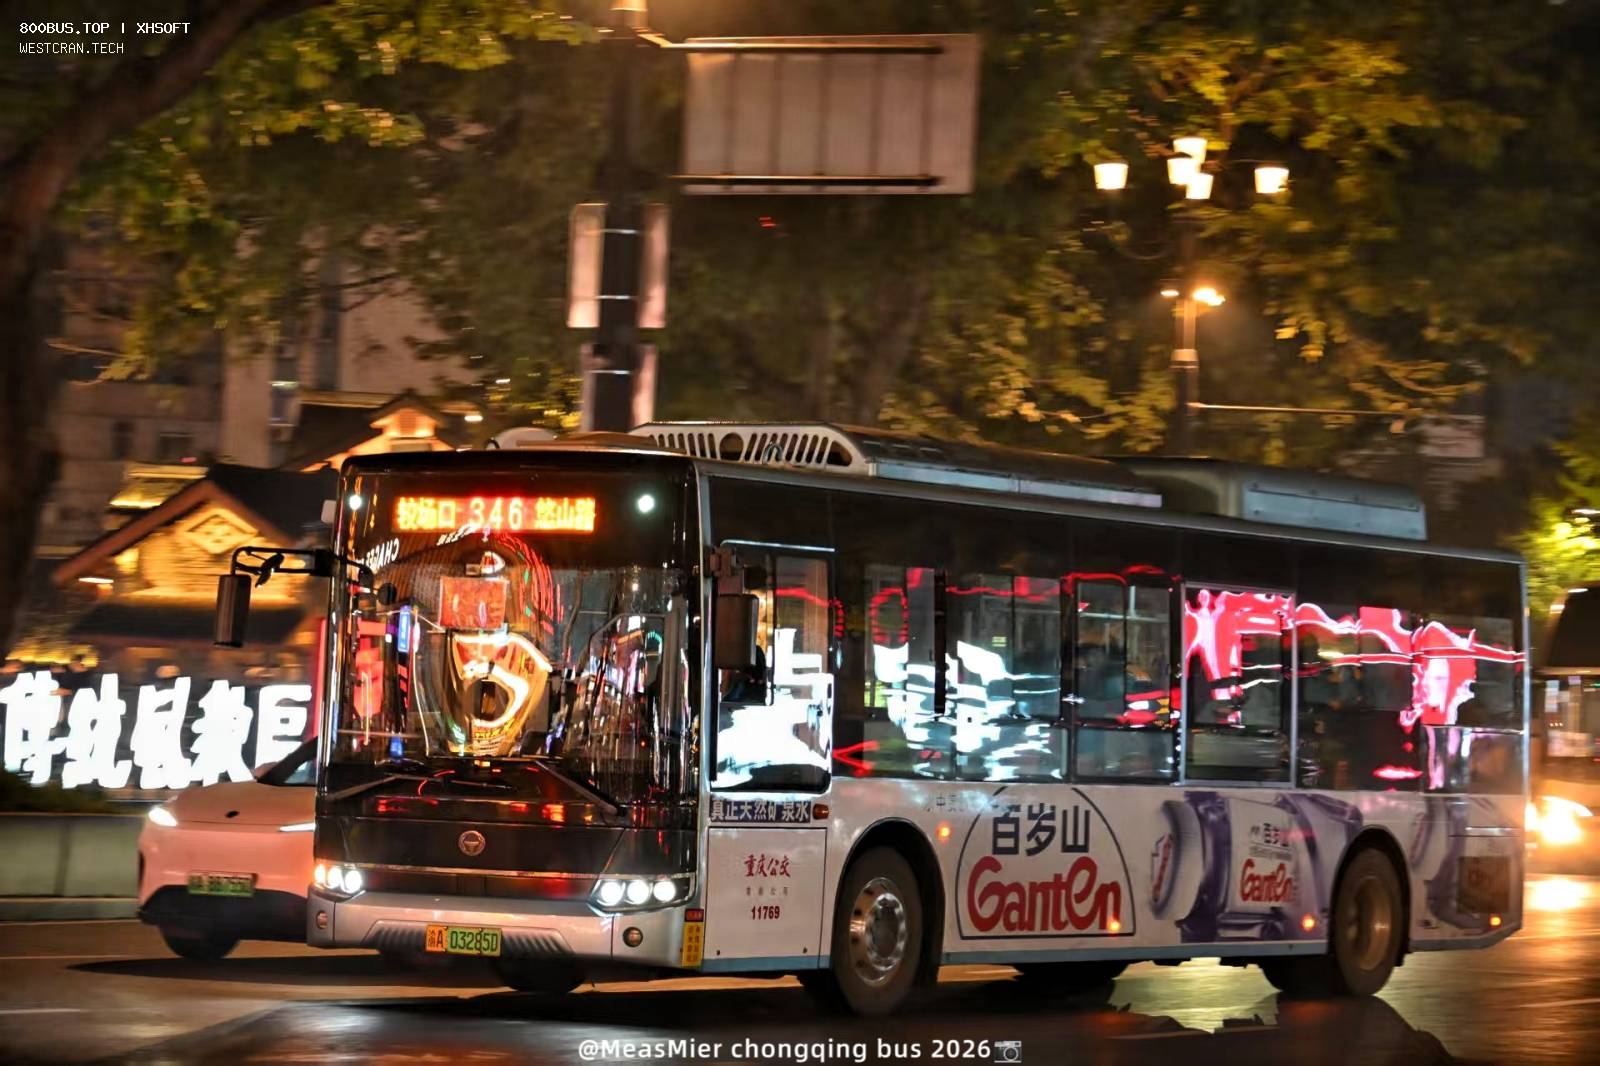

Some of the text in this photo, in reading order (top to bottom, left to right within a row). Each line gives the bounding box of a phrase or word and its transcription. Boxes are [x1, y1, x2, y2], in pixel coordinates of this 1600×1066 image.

[469, 497, 524, 530] 346
[991, 803, 1091, 857] 百岁山
[744, 854, 791, 878] 重庆公交
[967, 855, 1122, 932] Ganten
[751, 905, 780, 920] 11769
